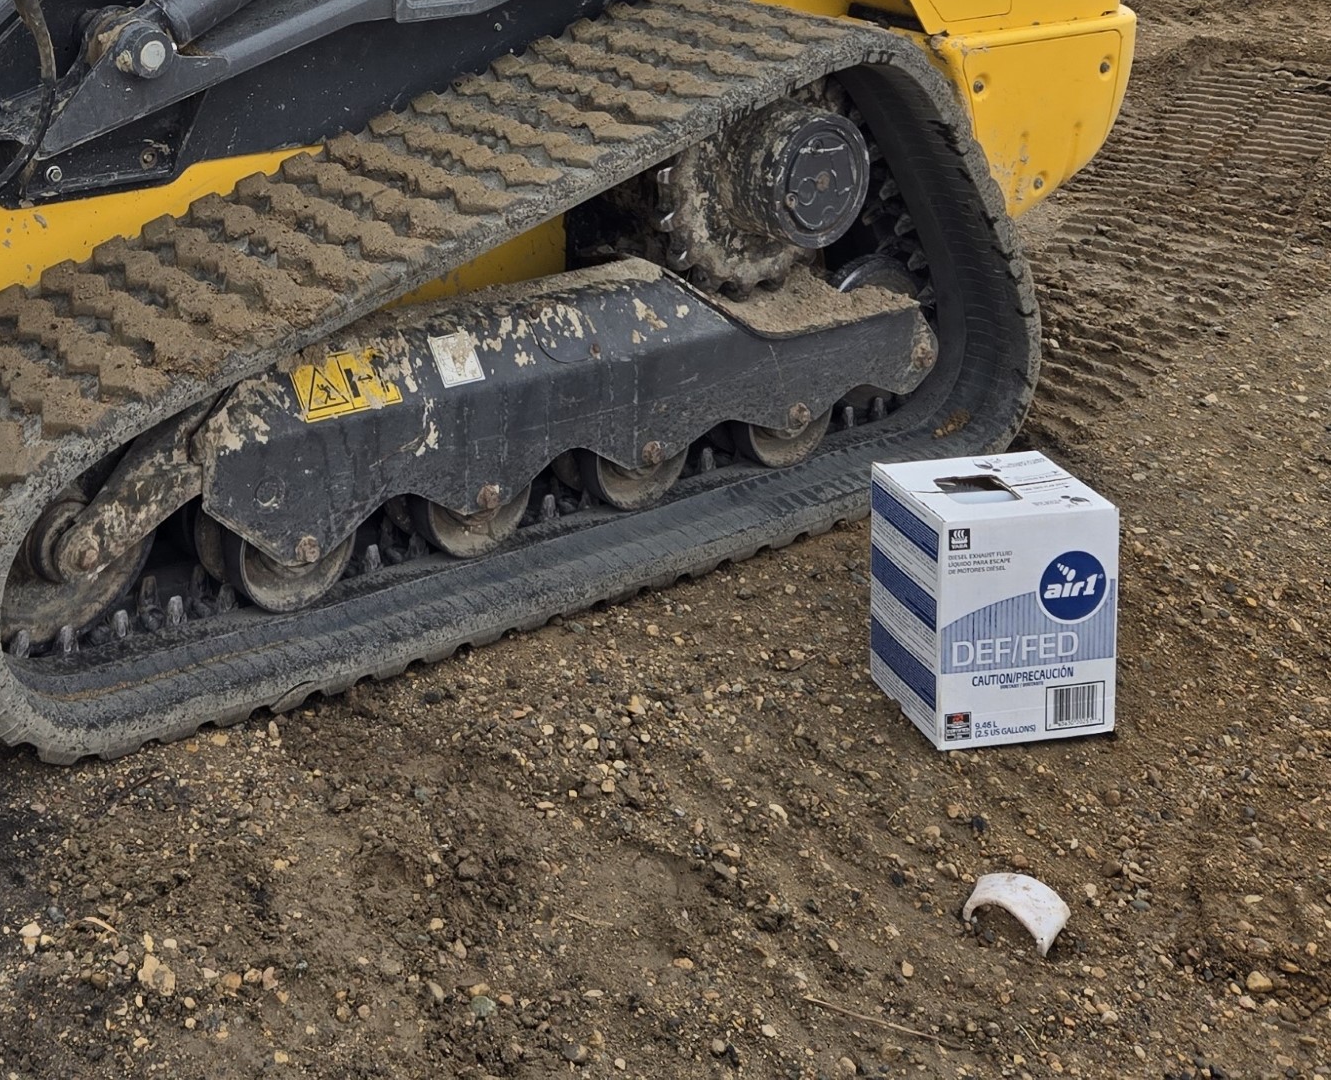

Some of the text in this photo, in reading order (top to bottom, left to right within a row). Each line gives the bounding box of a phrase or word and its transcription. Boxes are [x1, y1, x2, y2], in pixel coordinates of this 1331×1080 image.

[969, 551, 995, 560] EXHAUST
[989, 557, 1011, 565] ESCAPE
[957, 566, 986, 574] MOTORES
[1043, 563, 1098, 599] air1
[952, 631, 1079, 667] DEF/FED
[971, 665, 1074, 687] CAUTION/PRECAUCIÓN
[975, 721, 993, 730] 9.46
[975, 724, 1036, 739] (2.5 US GALLONS)
